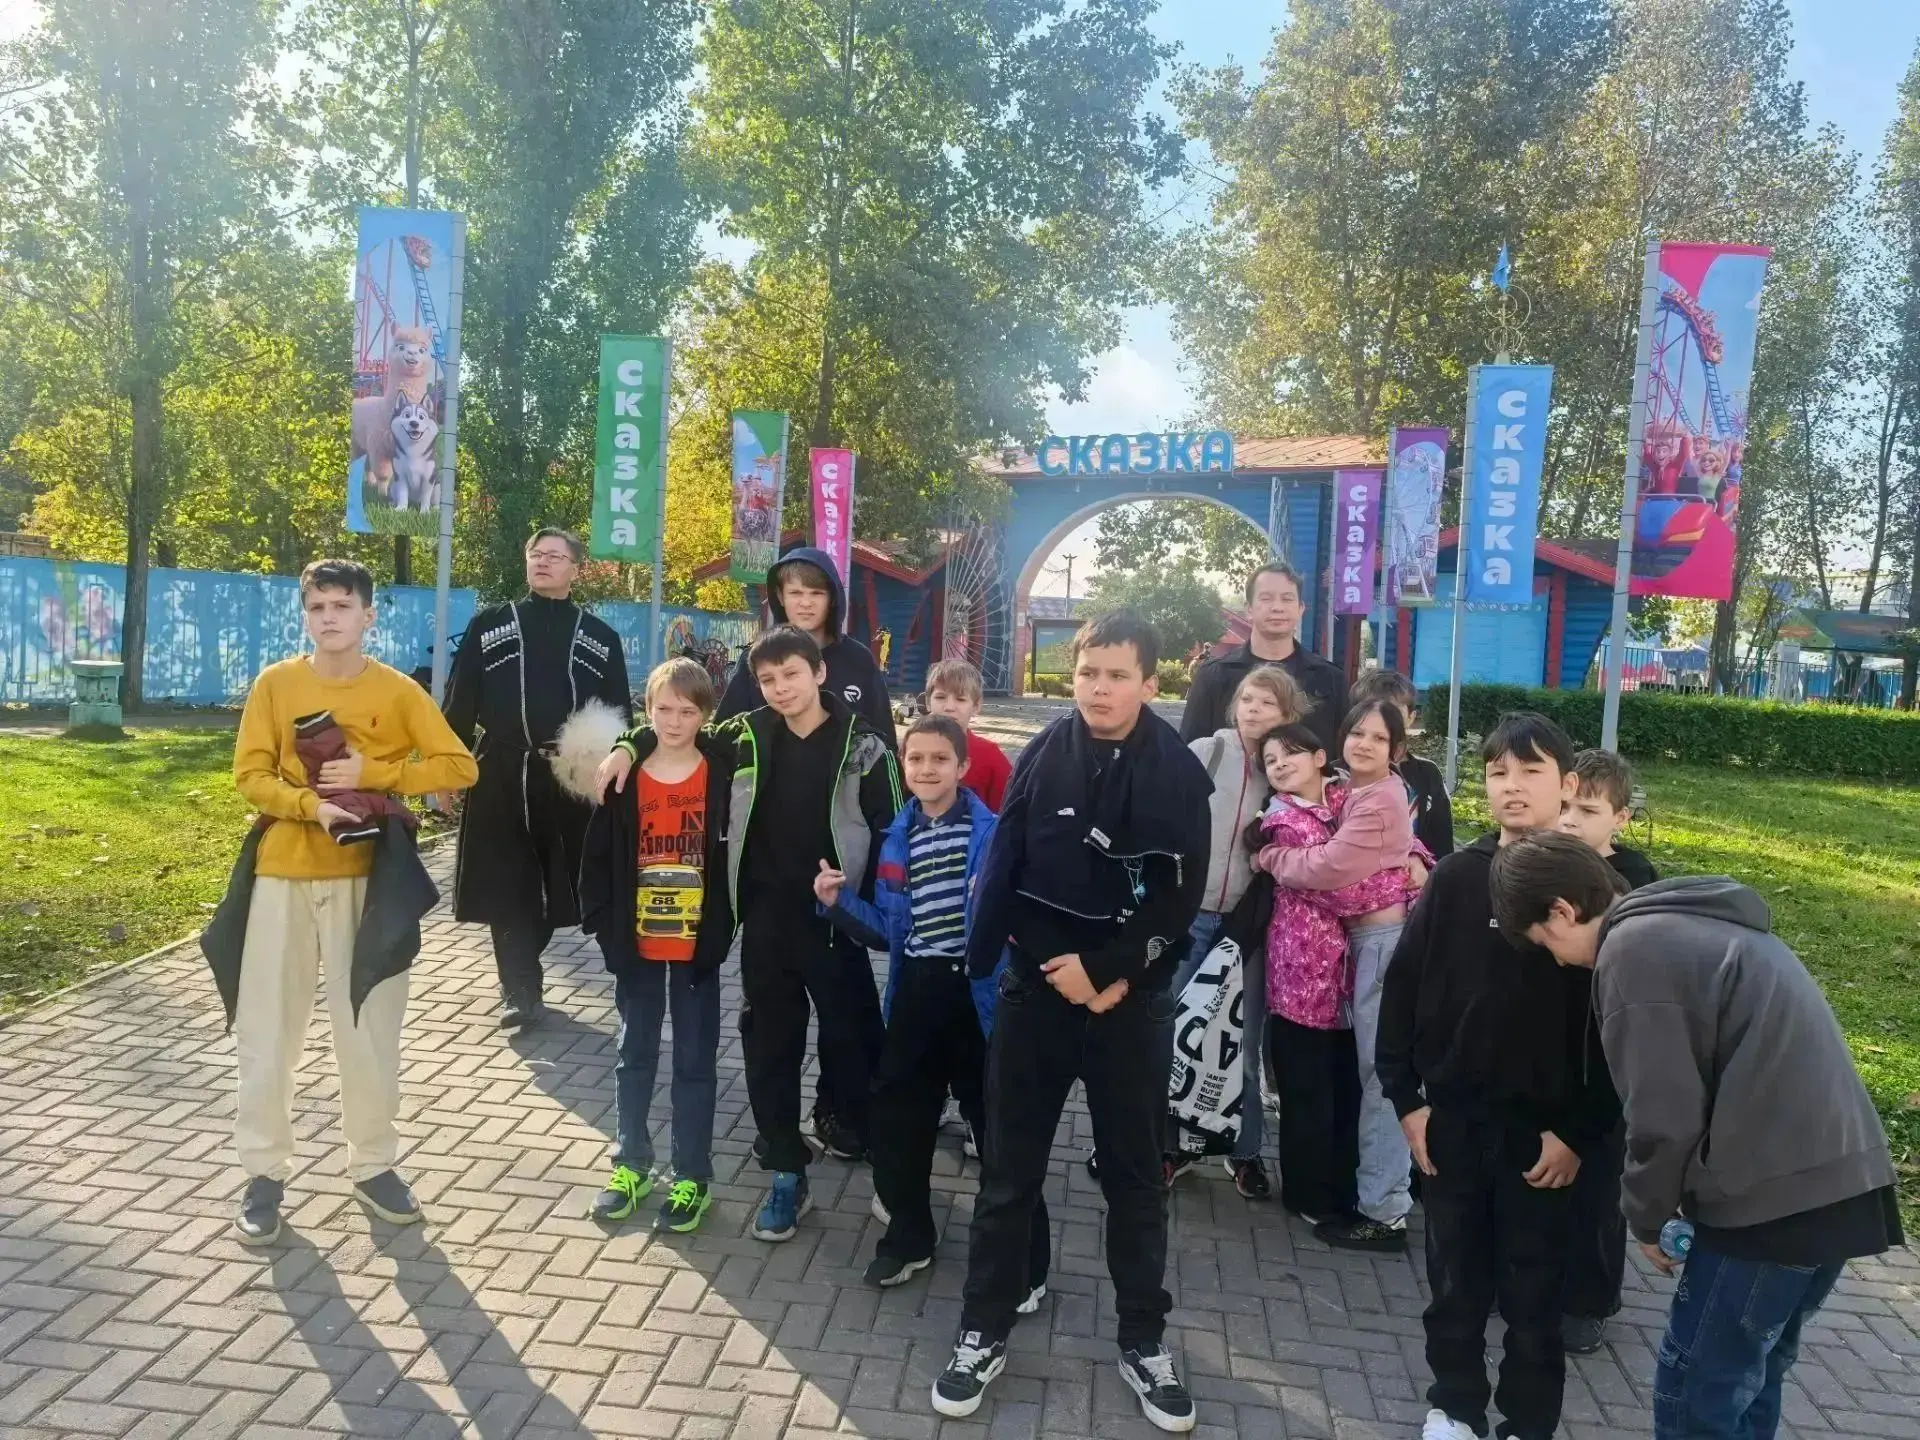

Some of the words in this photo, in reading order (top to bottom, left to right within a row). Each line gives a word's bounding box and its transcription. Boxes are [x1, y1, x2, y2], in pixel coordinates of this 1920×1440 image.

[1038, 431, 1233, 476] СКАЗКА
[821, 463, 839, 567] сказк
[652, 897, 676, 905] 68
